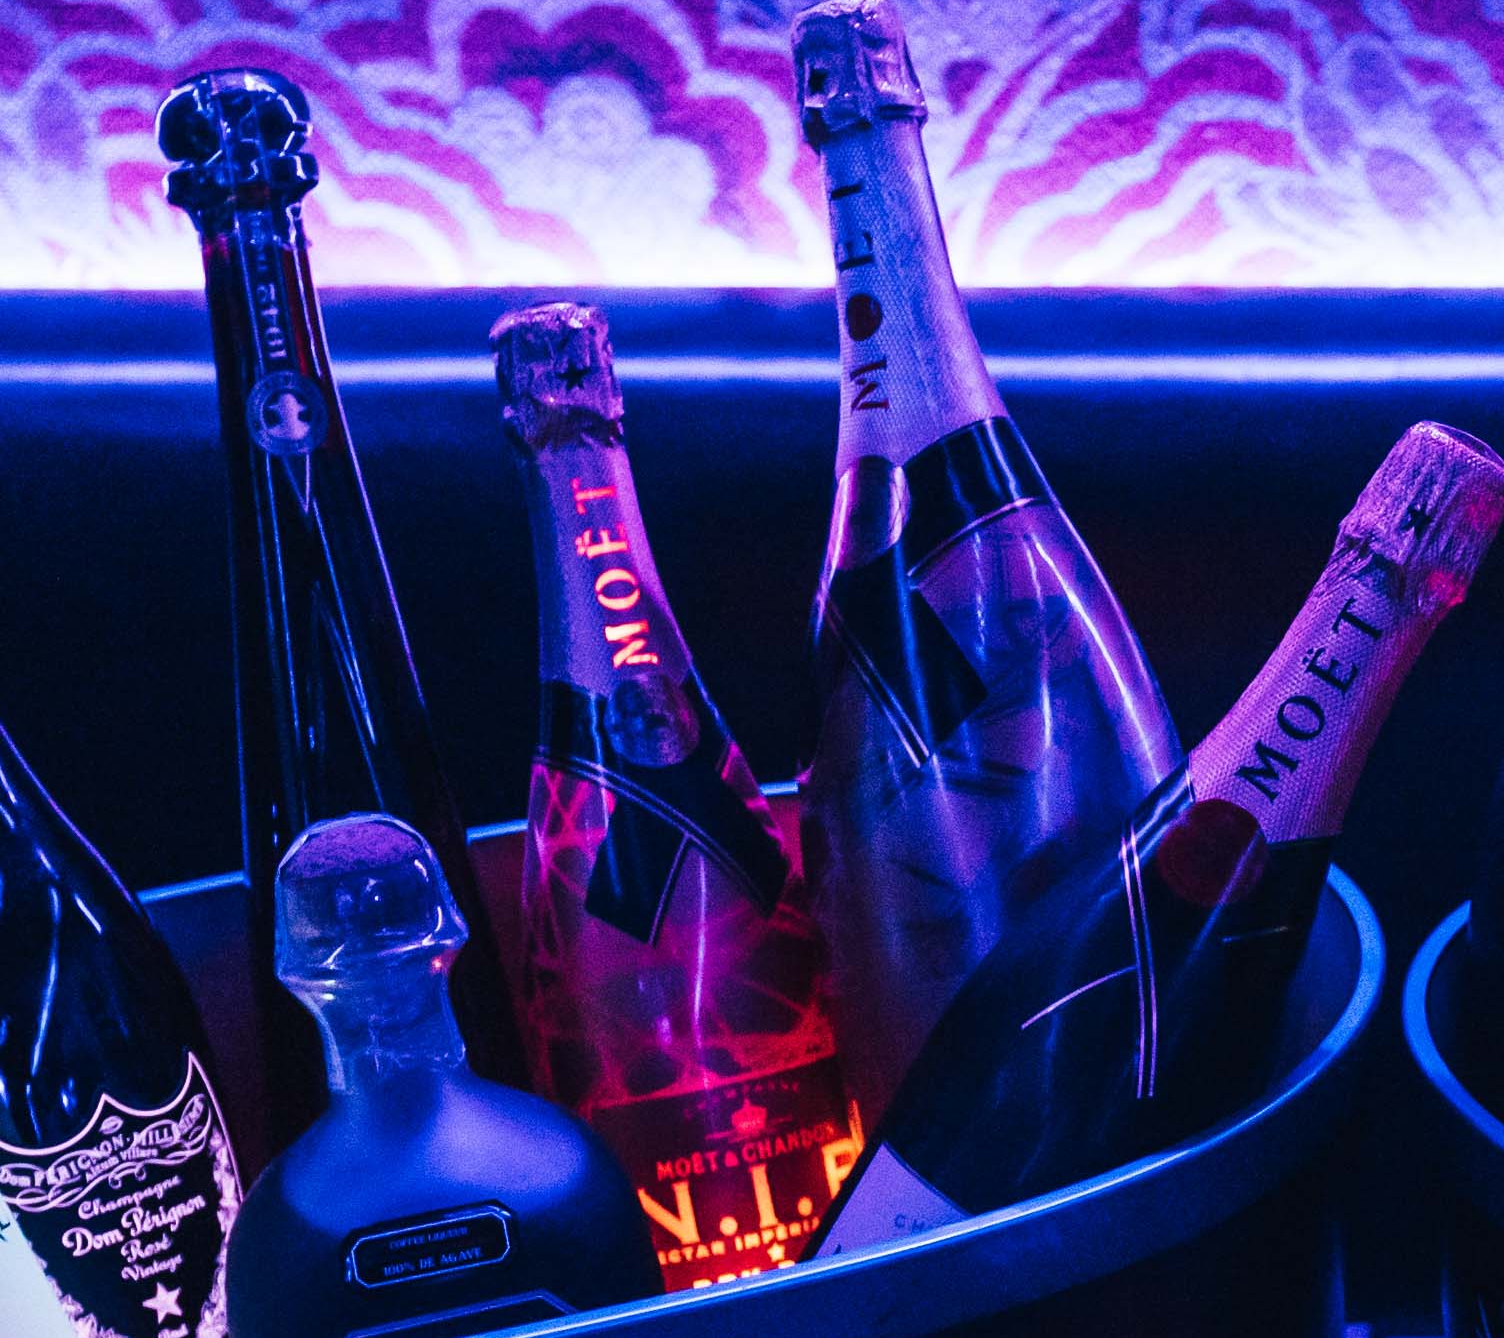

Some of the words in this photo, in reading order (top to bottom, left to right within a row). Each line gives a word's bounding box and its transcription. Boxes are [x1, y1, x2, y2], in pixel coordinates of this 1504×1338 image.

[571, 477, 659, 670] MOËT
[1234, 598, 1383, 802] MOËT
[61, 1226, 124, 1257] Dom
[121, 1194, 207, 1237] Pérignon
[78, 1174, 182, 1220] Champagne
[419, 1256, 436, 1270] DE
[439, 1246, 483, 1265] AGAVE
